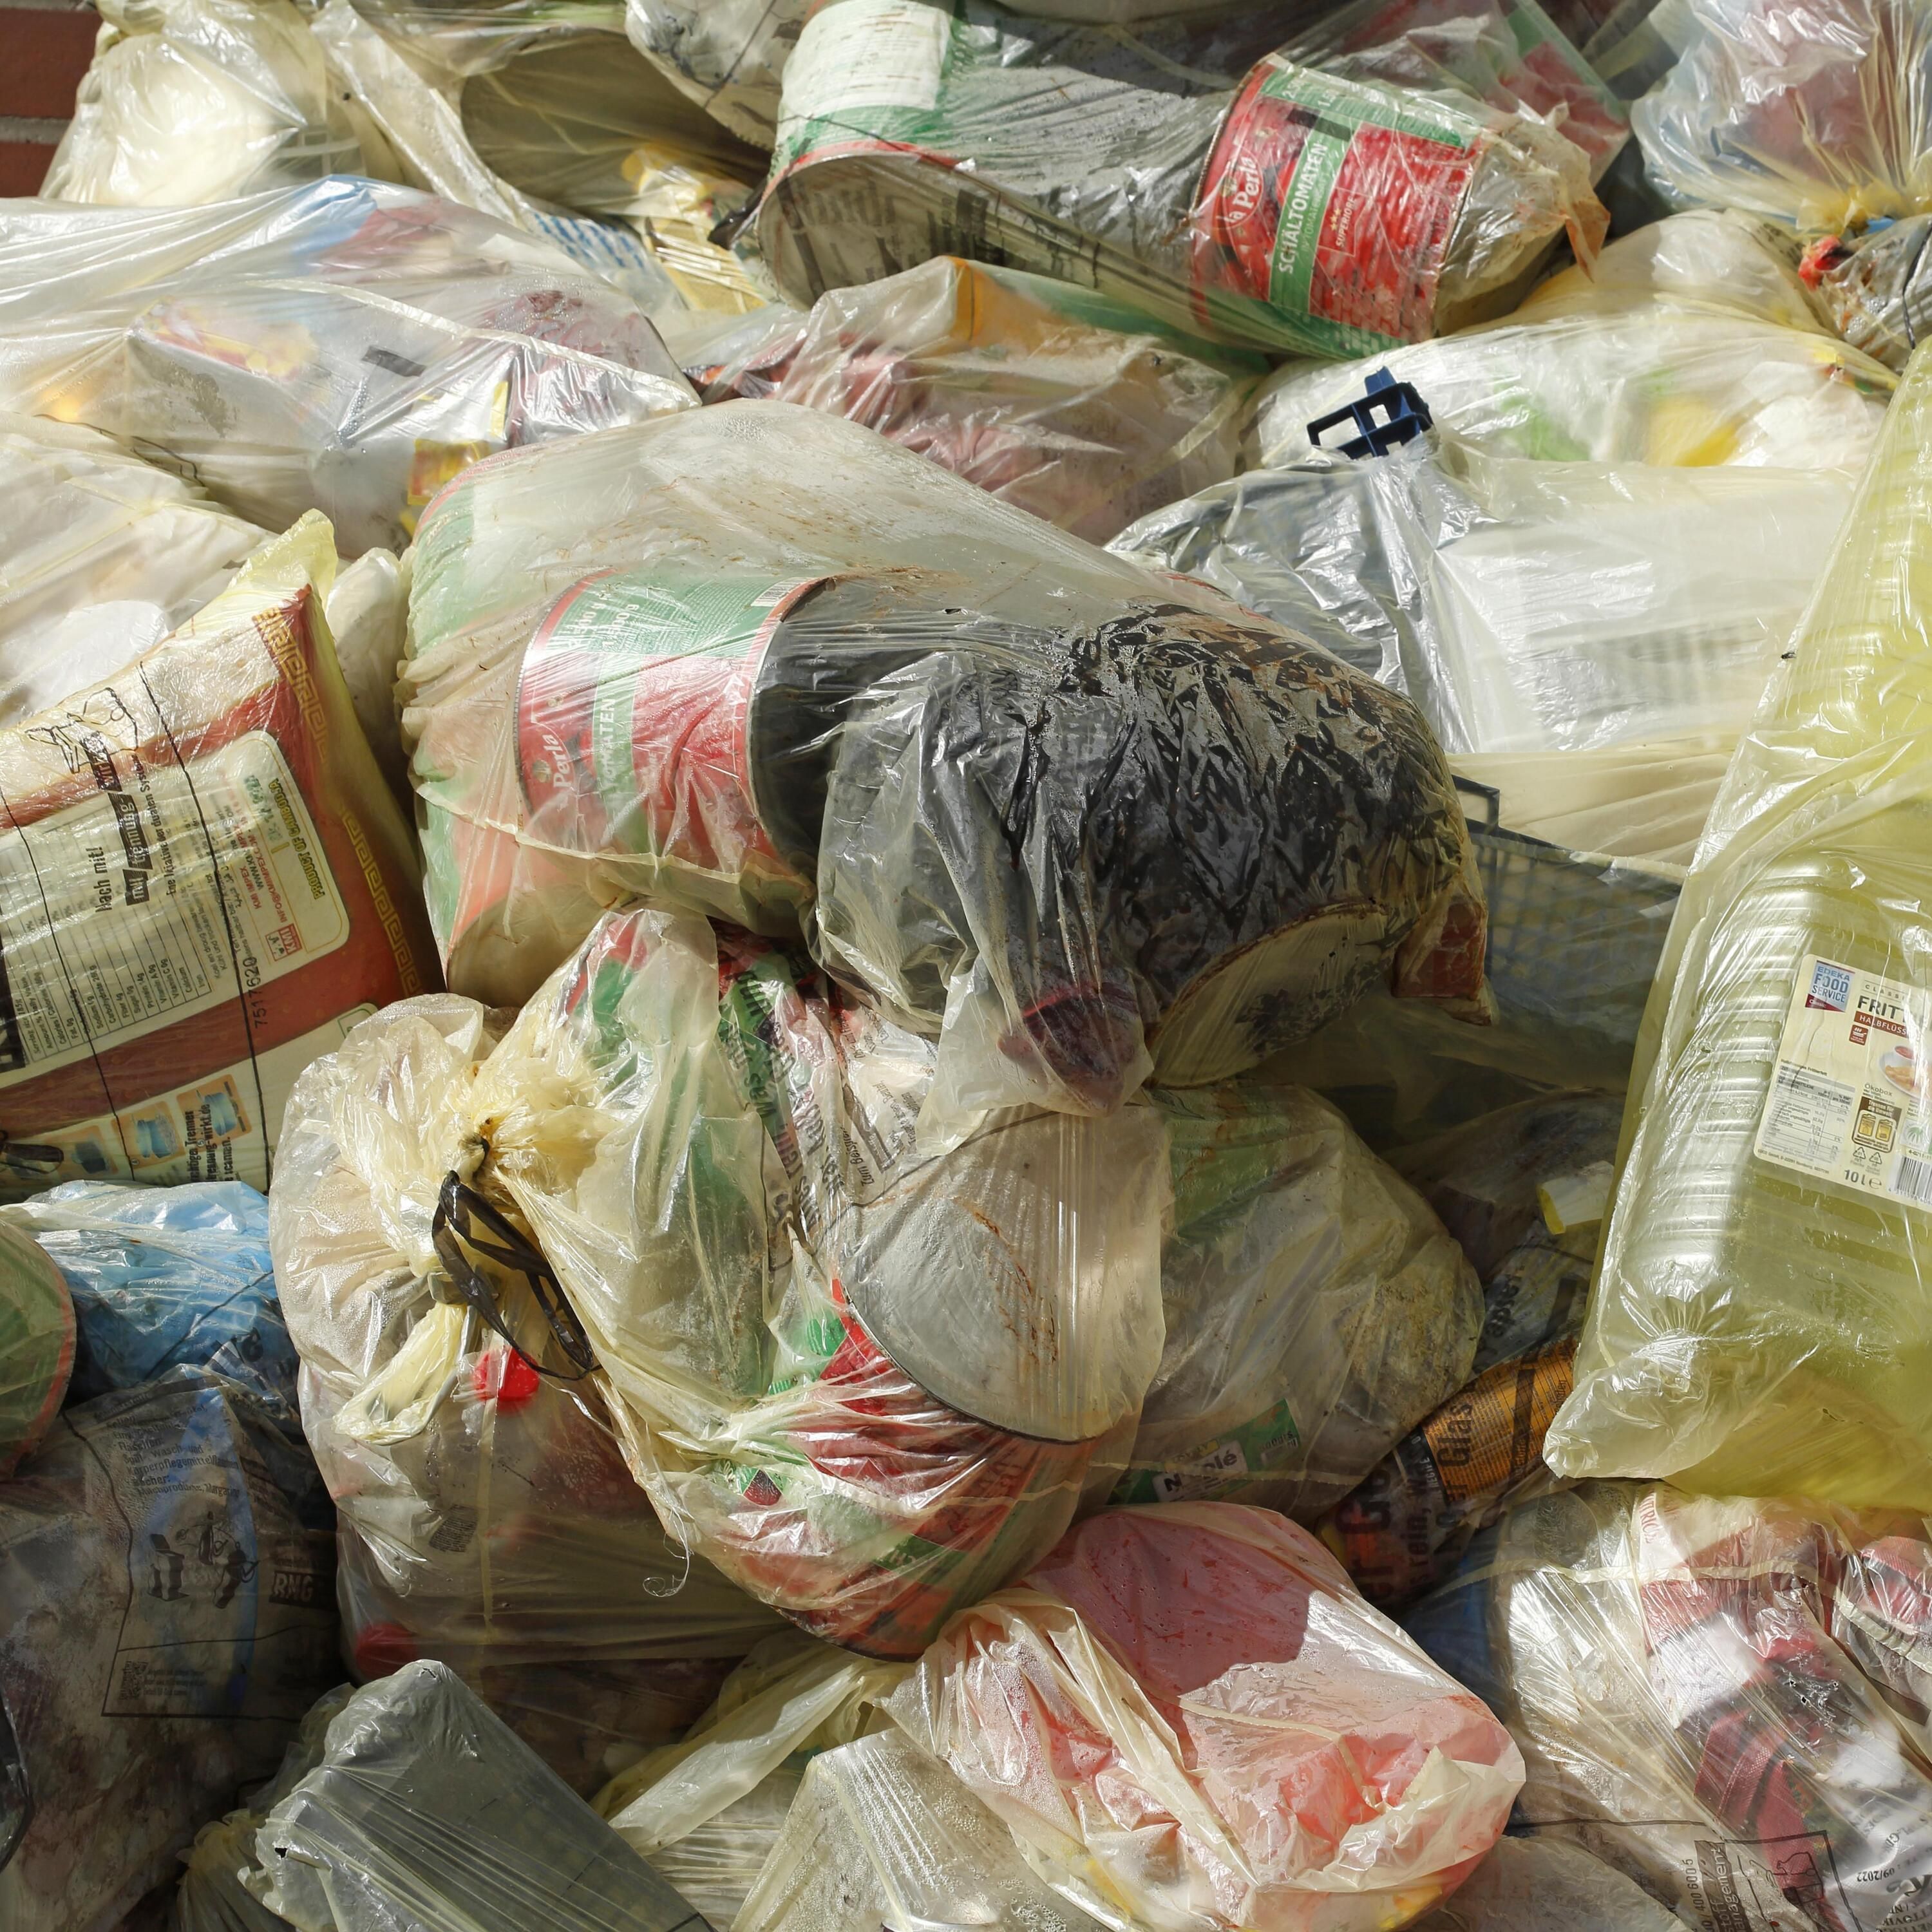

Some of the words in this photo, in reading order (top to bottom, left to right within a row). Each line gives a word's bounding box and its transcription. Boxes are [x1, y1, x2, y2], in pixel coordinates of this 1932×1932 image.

[1233, 157, 1258, 209] Perla
[1278, 140, 1327, 274] SCHÄLTOMATEN
[1335, 194, 1356, 248] SUPERIORE
[552, 732, 572, 790] Perla
[144, 793, 162, 828] dualen
[267, 777, 301, 838] CAMBODJA
[292, 835, 307, 853] OF
[86, 844, 109, 876] mit!
[239, 865, 256, 893] IMPEX
[298, 850, 327, 900] PRODUCT
[251, 893, 262, 909] KMI
[211, 940, 222, 954] und
[279, 927, 298, 953] KMI
[147, 963, 158, 974] 0g
[159, 958, 170, 969] 0g
[1817, 965, 1852, 981] EDEKA
[153, 979, 167, 1004] Vitamin
[166, 974, 180, 998] Vitamin
[177, 967, 193, 994] Calcium
[243, 956, 269, 1029] 7517620
[1814, 974, 1850, 994] FOOD
[1864, 983, 1907, 1001] CLASSI
[95, 981, 117, 1024] Carbohydrate
[128, 994, 142, 1014] Sugar
[140, 985, 155, 1009] Protein
[1811, 985, 1847, 1003] SERVICE
[90, 1005, 104, 1029] Sodium
[37, 1023, 53, 1050] Amount
[52, 1019, 67, 1045] Calories
[183, 1110, 197, 1147] Trenner
[855, 1164, 875, 1188] Zum
[1842, 1168, 1861, 1184] 10
[1686, 1868, 1698, 1889] 600
[1855, 1866, 1896, 1884] 09/2022
[1690, 1893, 1706, 1910] 400
